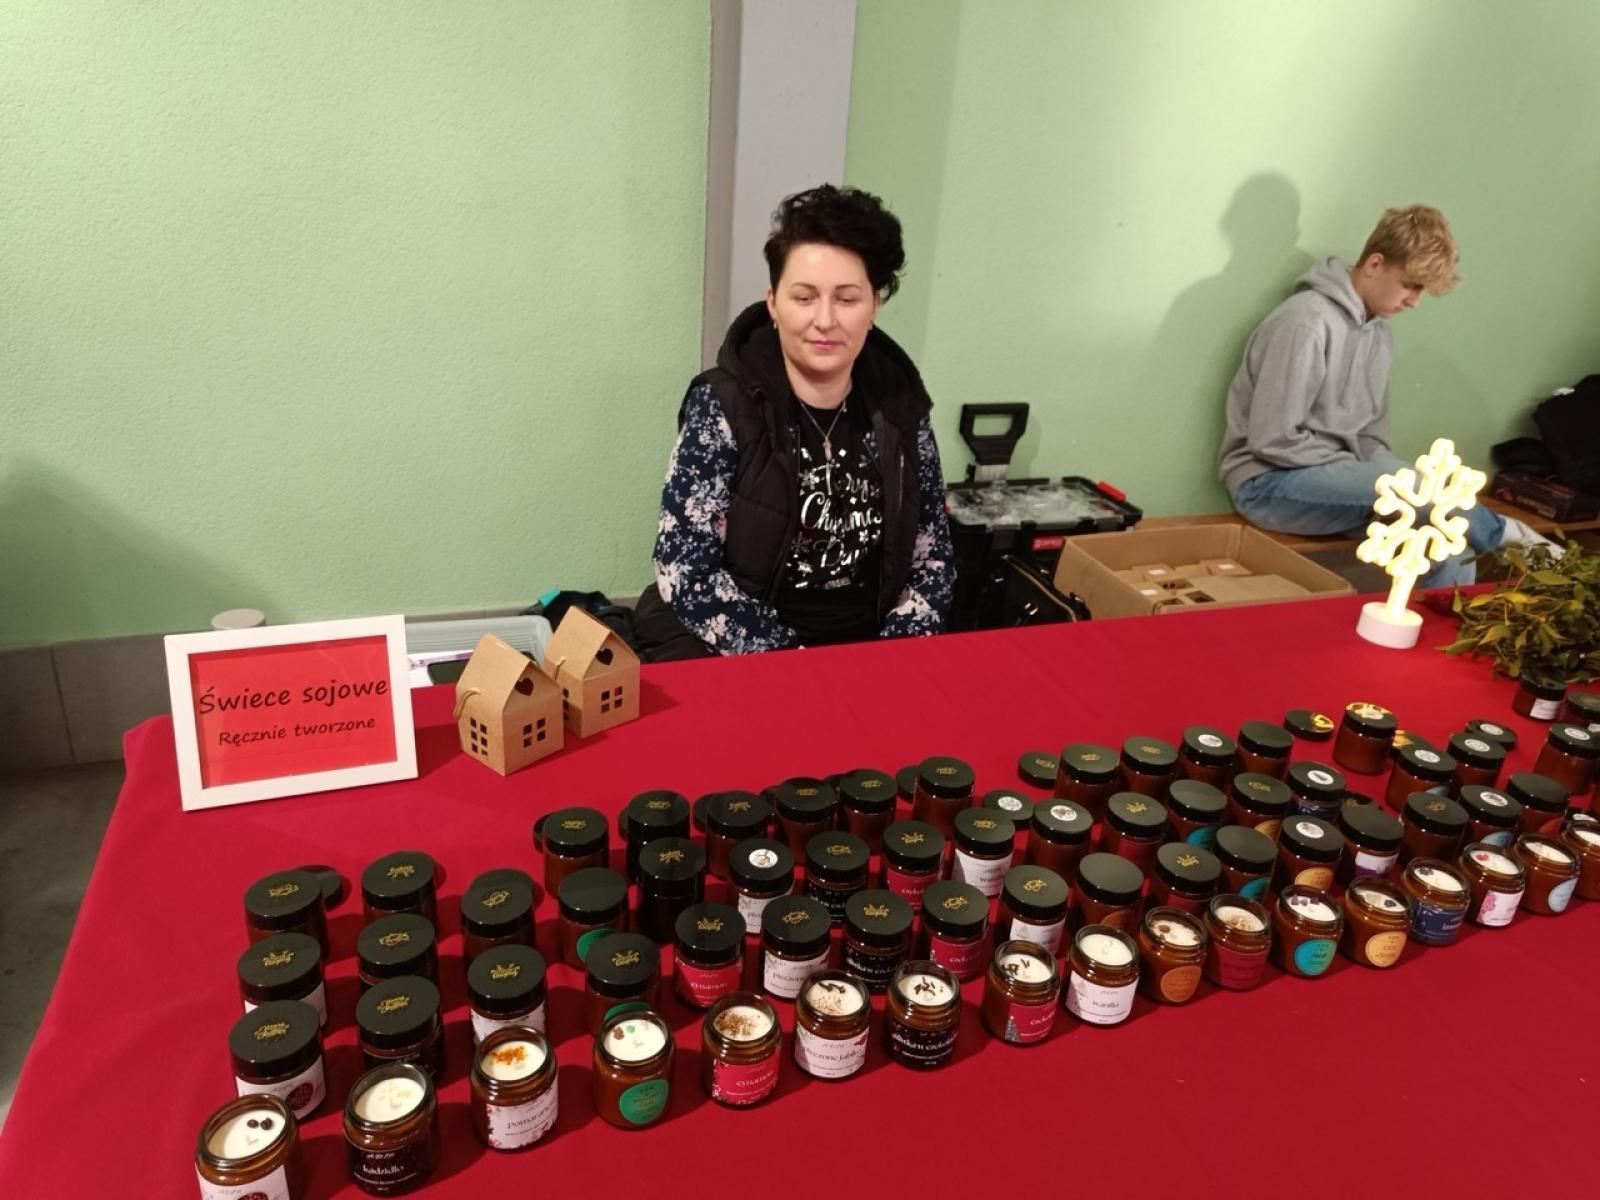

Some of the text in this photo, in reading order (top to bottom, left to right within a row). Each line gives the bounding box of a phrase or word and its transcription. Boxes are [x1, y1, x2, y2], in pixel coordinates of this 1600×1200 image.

[199, 679, 388, 715] Świece sojowe
[218, 718, 376, 747] Ręcznie tworzone
